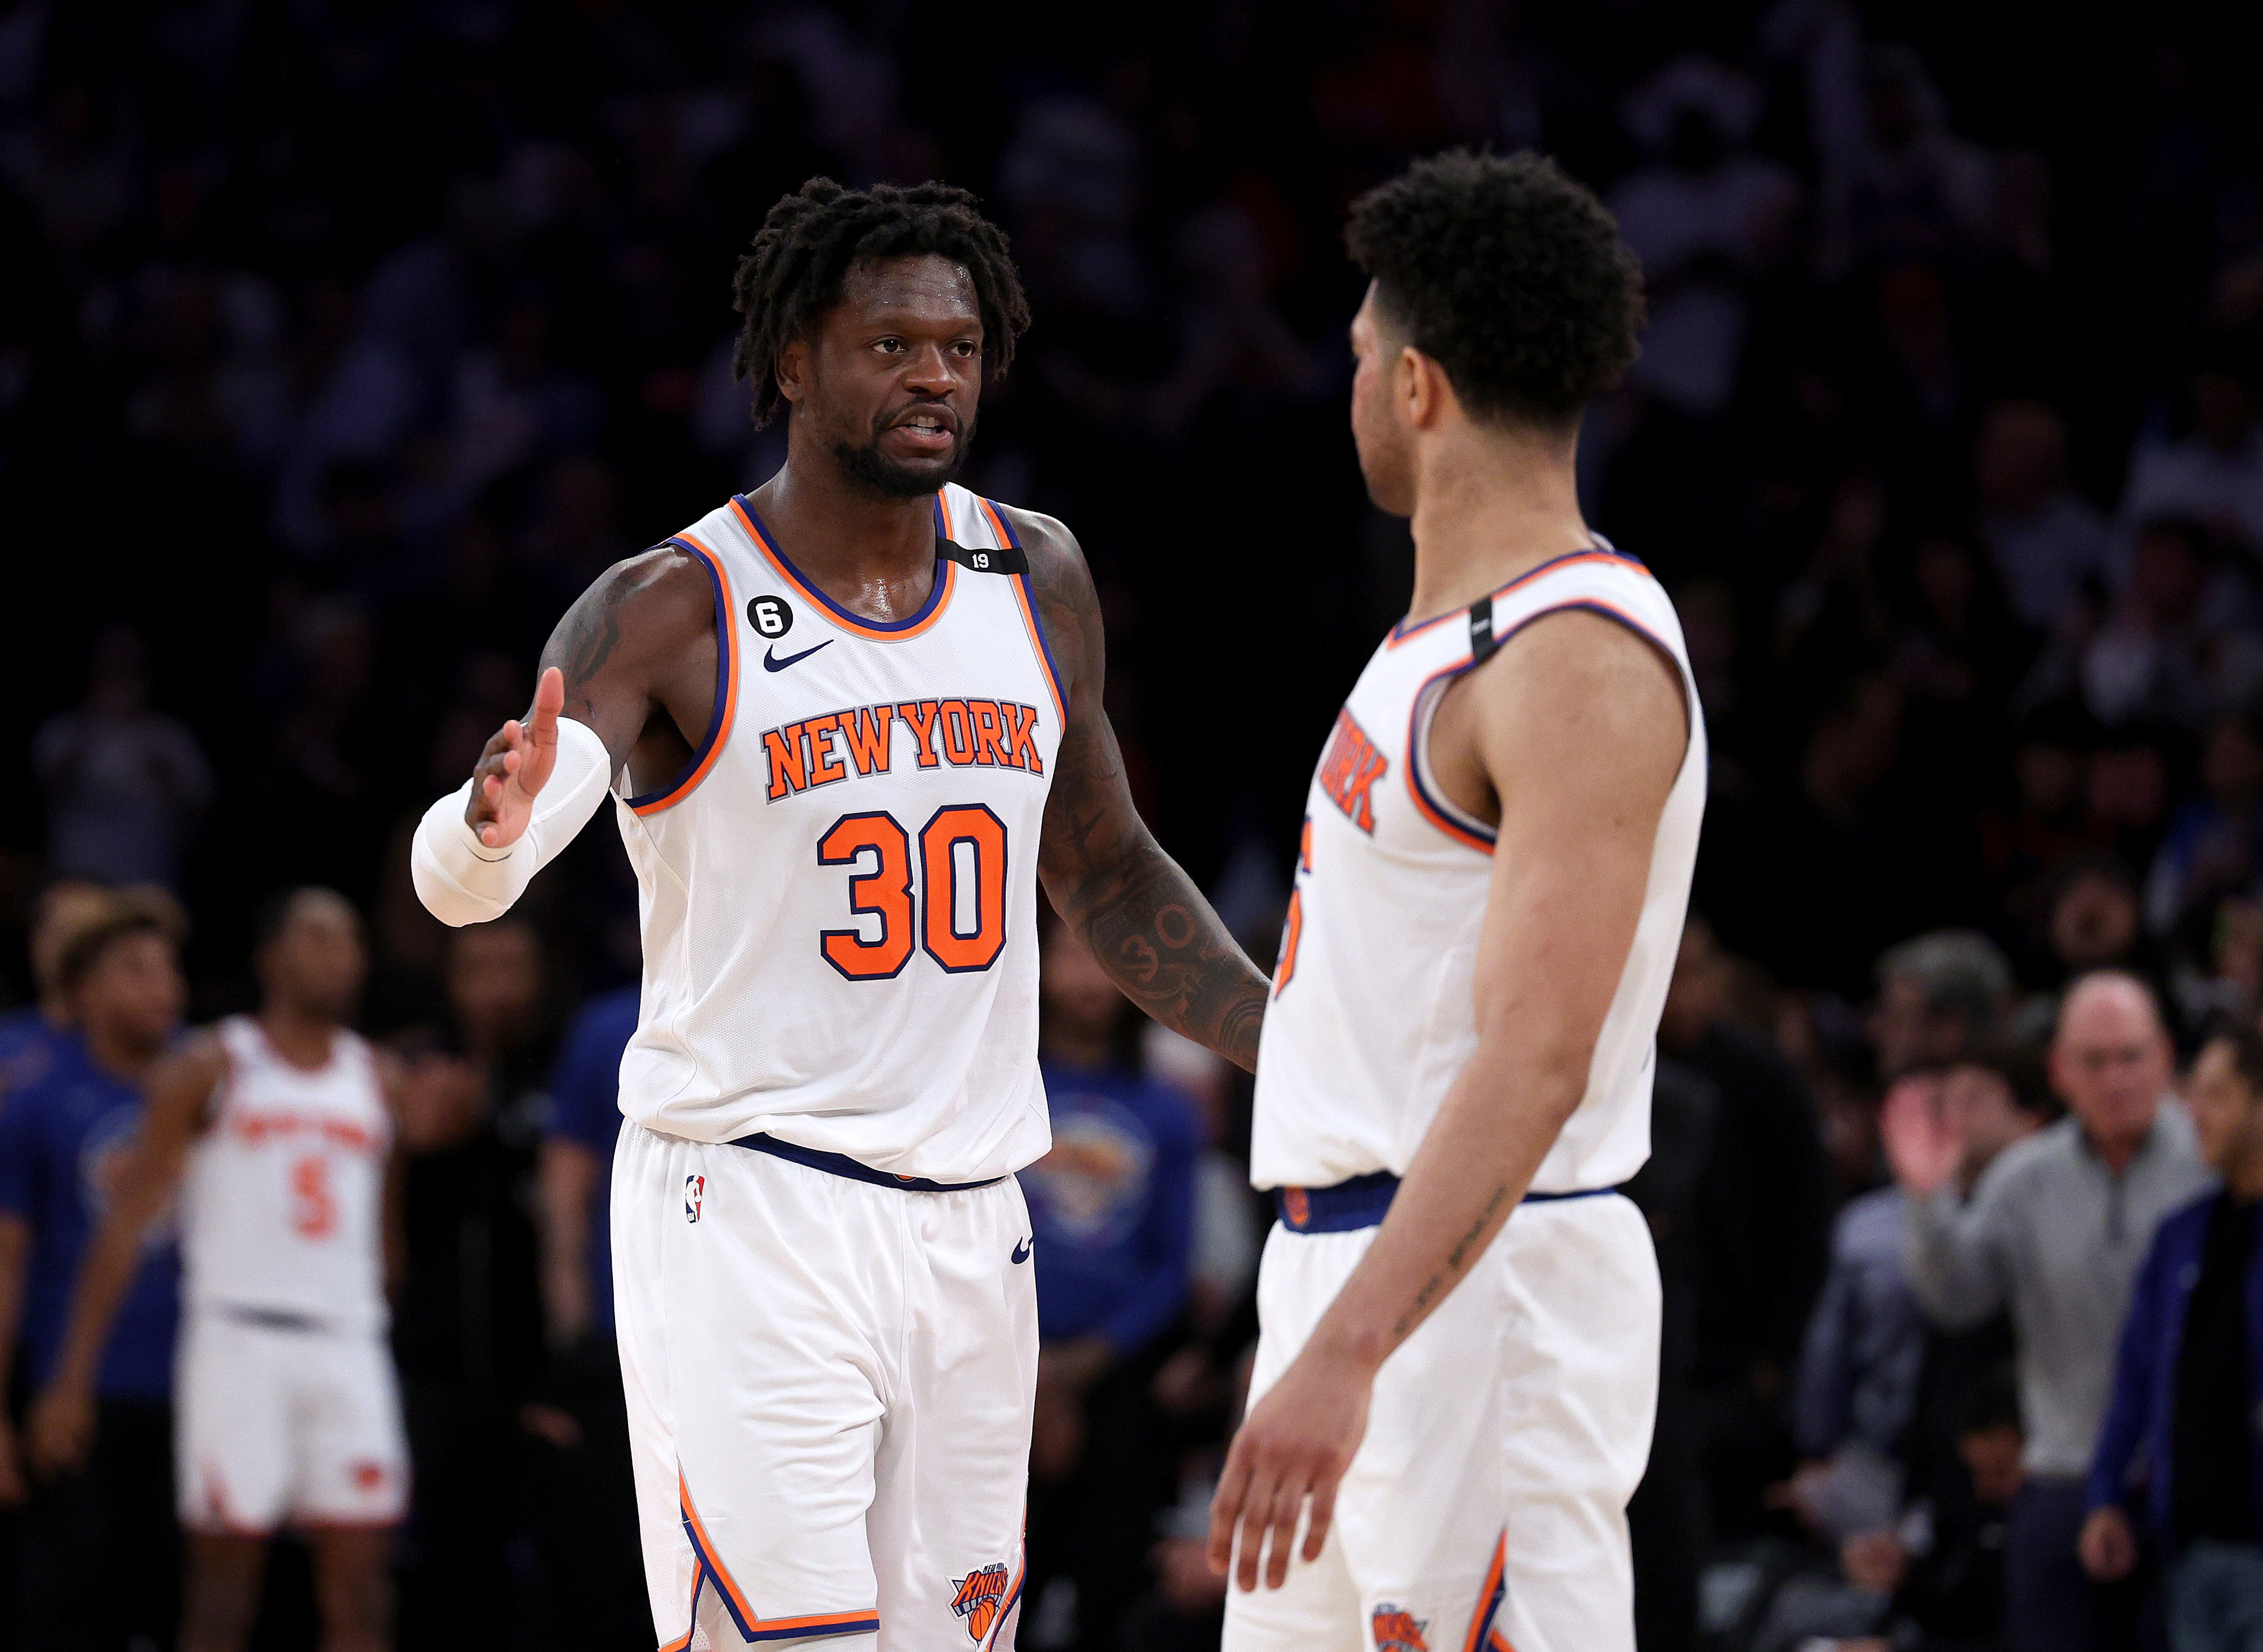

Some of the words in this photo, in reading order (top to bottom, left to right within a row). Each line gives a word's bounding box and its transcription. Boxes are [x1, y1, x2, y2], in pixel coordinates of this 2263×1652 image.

[972, 553, 989, 569] 19
[755, 601, 784, 633] 6
[759, 703, 897, 805] NEW
[896, 696, 1044, 778] YORK
[817, 803, 1008, 982] 30
[1120, 904, 1196, 982] 30
[951, 1567, 1008, 1607] KNICKS
